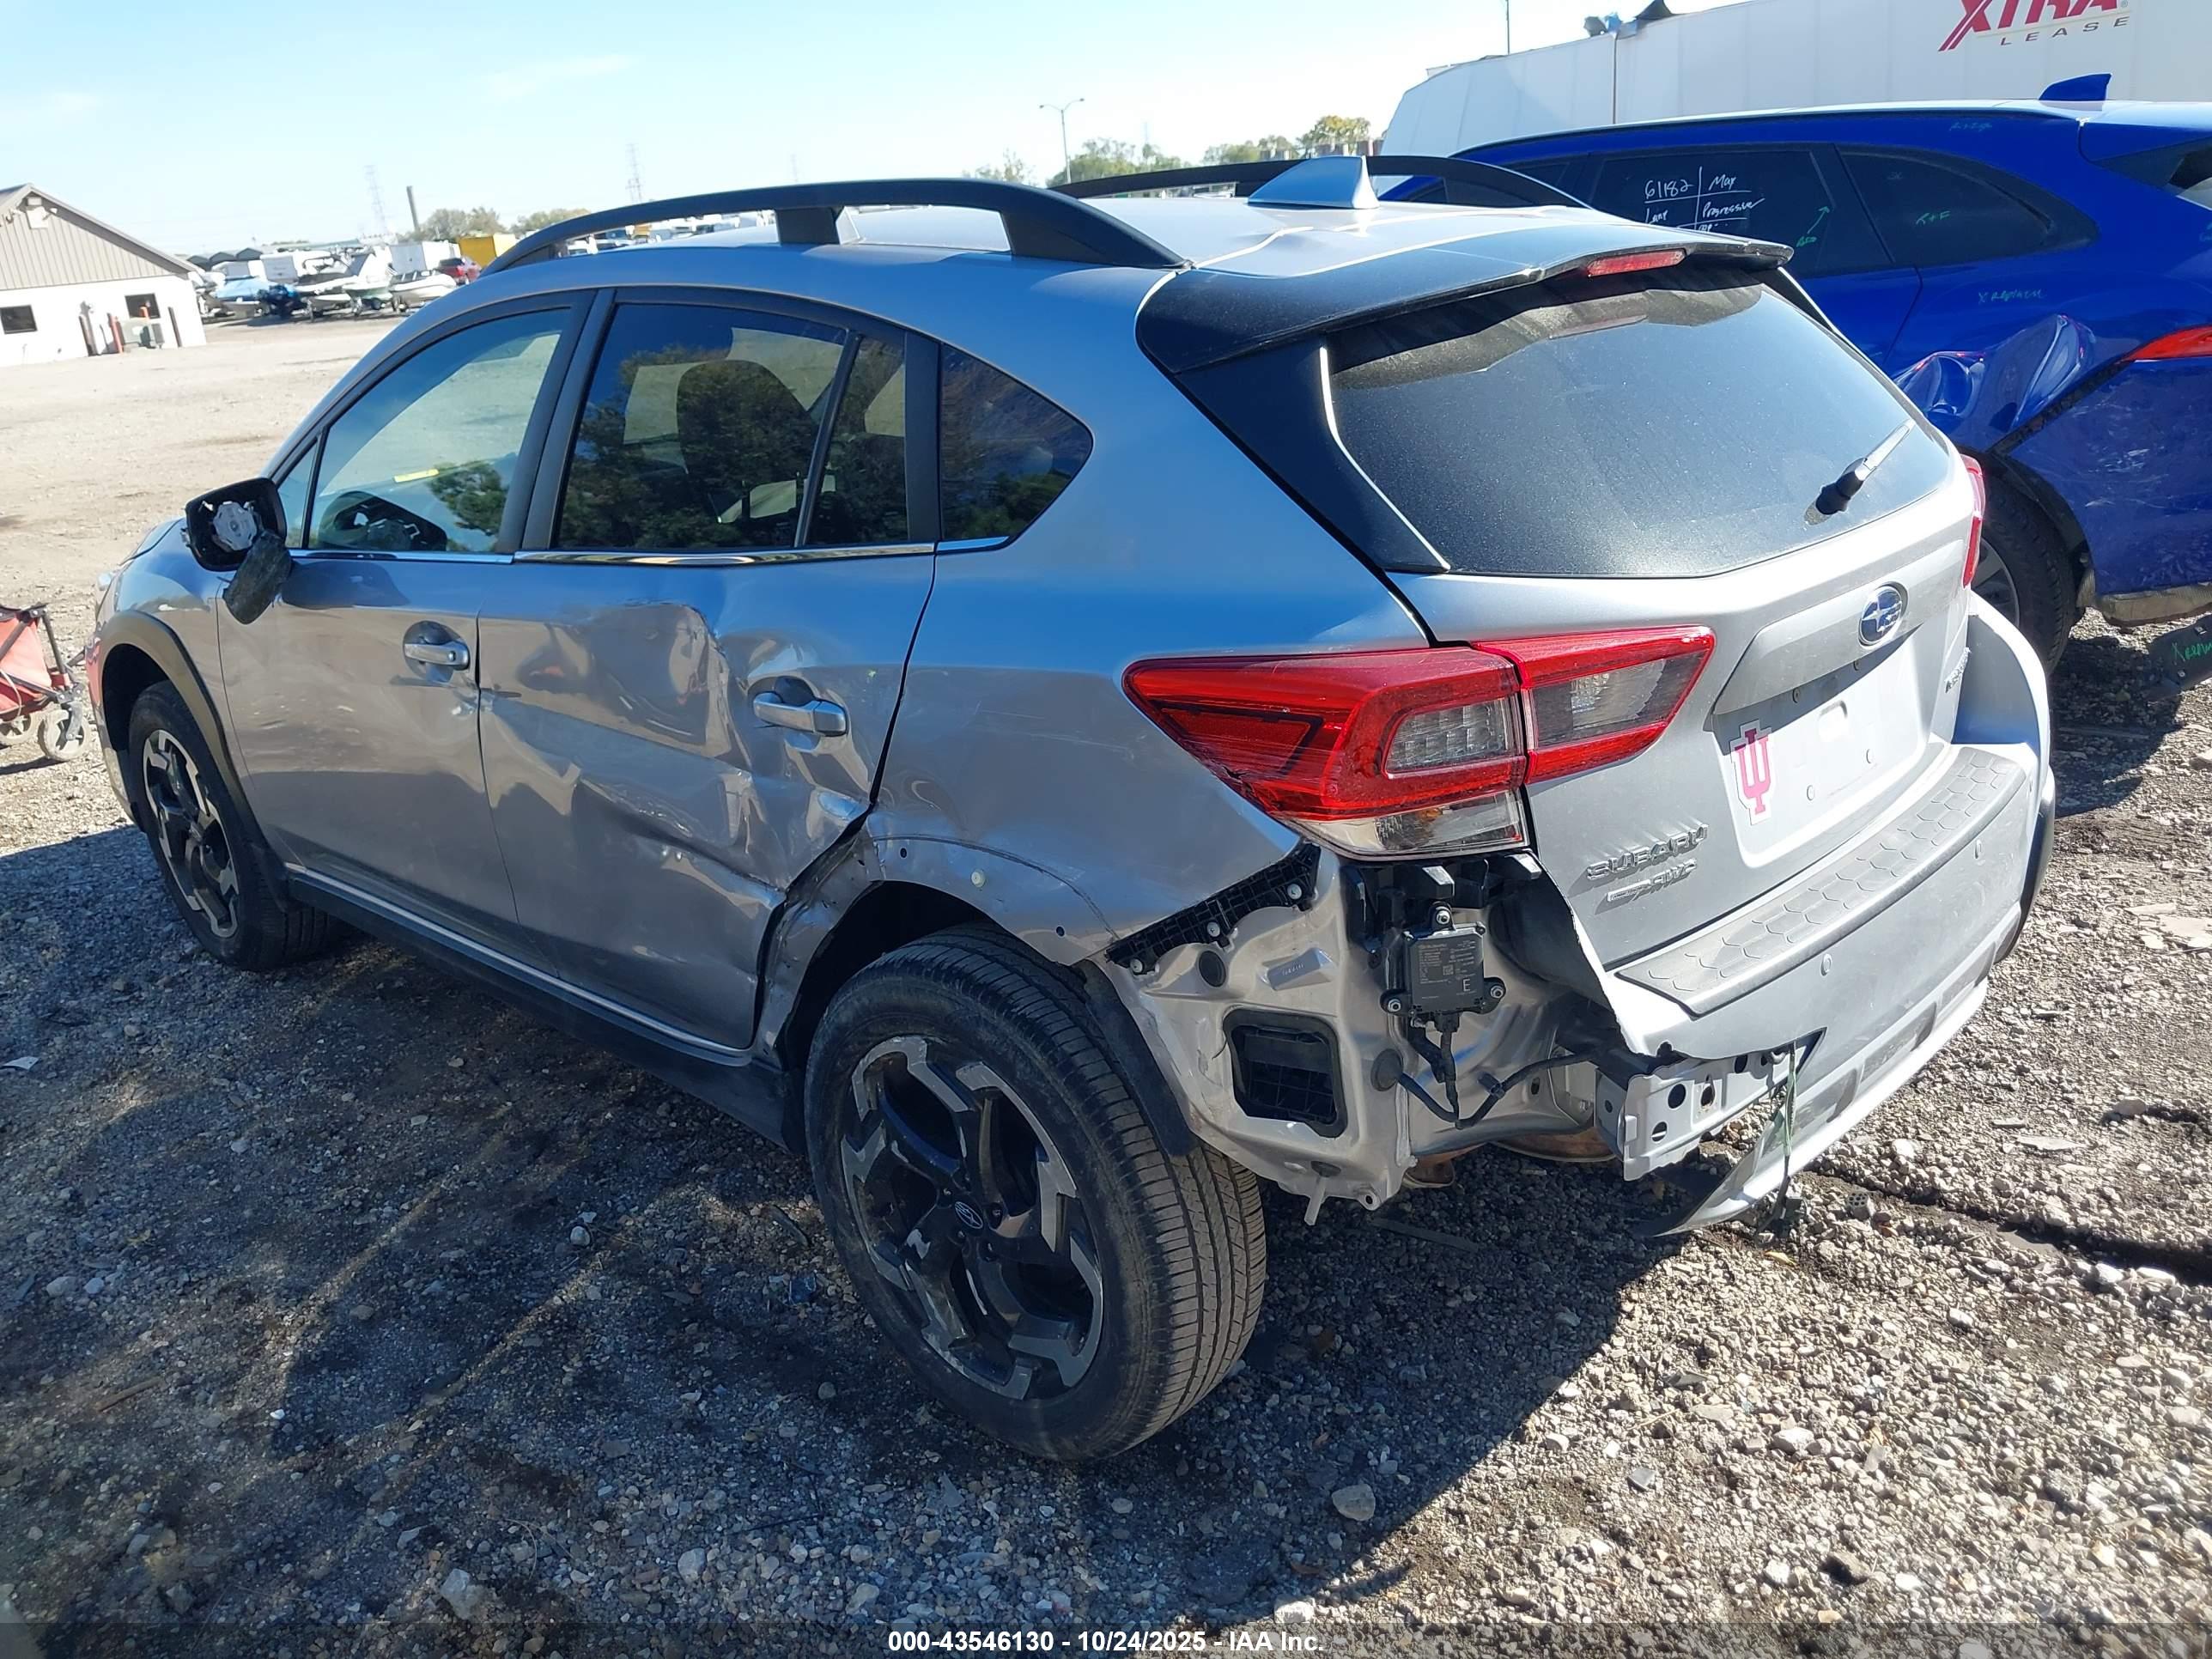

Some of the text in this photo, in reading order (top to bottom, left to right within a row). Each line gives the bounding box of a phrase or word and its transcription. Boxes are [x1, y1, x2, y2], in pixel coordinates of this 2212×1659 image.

[2000, 15, 2130, 46] LEASE
[1644, 179, 1693, 199] 61182
[1587, 823, 1709, 880] SUBARU
[1462, 978, 1471, 992] E
